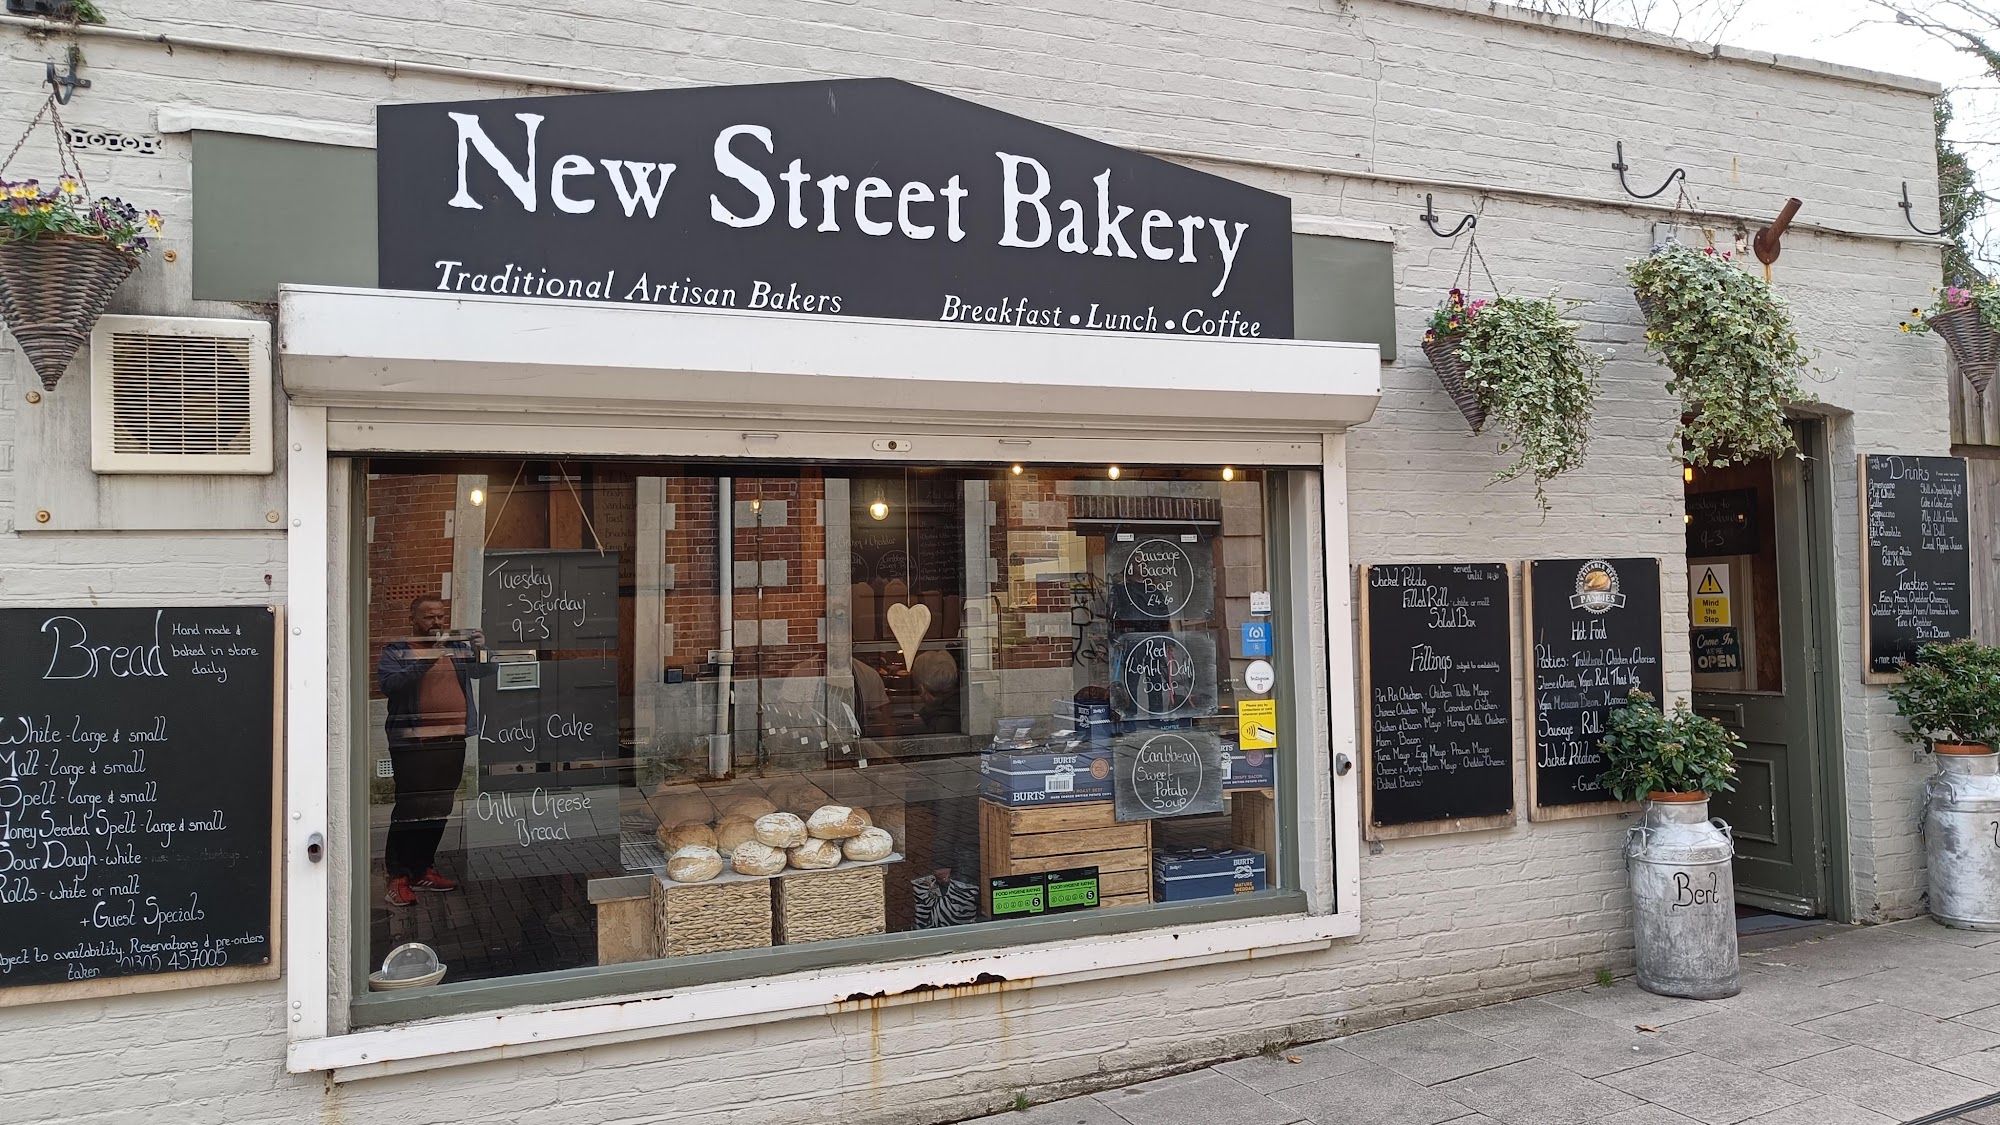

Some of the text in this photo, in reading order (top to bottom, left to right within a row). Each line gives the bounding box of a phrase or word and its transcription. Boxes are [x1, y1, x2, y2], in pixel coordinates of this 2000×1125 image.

[448, 111, 1250, 298] New Street Bakery
[435, 260, 842, 313] Traditional Artisan Bakers
[940, 294, 1261, 338] Breakfast Lunch Coffee
[1886, 456, 1930, 481] Drinks
[1135, 548, 1180, 567] Sausage
[489, 560, 553, 597] Tuesday
[1138, 562, 1177, 577] Bacon
[1372, 564, 1472, 587] Jacket Potato served
[1896, 568, 1928, 591] Toasties
[1143, 578, 1173, 593] Bap
[1403, 588, 1427, 608] Filled
[1427, 586, 1449, 607] Roll
[1580, 594, 1615, 604] PASTIES
[519, 590, 586, 627] Saturday
[1428, 607, 1476, 628] Salad Box
[1571, 618, 1607, 640] Hot Food
[1704, 616, 1719, 624] Step
[1697, 633, 1734, 649] Come In
[1932, 626, 1950, 638] Bacon
[40, 610, 232, 679] Bread Hand made
[171, 643, 259, 657] baked in store
[1146, 640, 1167, 660] Red
[192, 661, 227, 683] daily
[1128, 657, 1161, 676] Lentil
[1410, 643, 1452, 684] Fillings
[1697, 654, 1736, 669] OPEN
[1143, 677, 1178, 694] Soup
[1595, 667, 1609, 686] Red
[1610, 666, 1627, 685] Thai
[0, 714, 62, 745] White
[128, 716, 168, 742] small
[479, 713, 594, 752] Lardy Cake
[1539, 711, 1604, 741] Sausage Rolls
[1375, 731, 1421, 746] Ham Bacon
[0, 749, 39, 777] Malt
[103, 749, 146, 774] small
[1053, 756, 1077, 764] BURTS
[1142, 745, 1197, 766] Caribbean
[1415, 745, 1428, 763] Egg
[1538, 741, 1600, 767] Jacket Potatoes
[1137, 764, 1173, 782] Sweet
[1013, 791, 1045, 801] BURTS
[1156, 777, 1188, 796] Potato
[0, 777, 56, 821] Spelt
[119, 781, 157, 802] small
[476, 786, 592, 824] Chilli Cheese
[1153, 797, 1186, 808] Soup
[39, 810, 90, 838] Seeded
[96, 809, 137, 850] Spelt
[188, 810, 227, 831] small
[514, 818, 570, 847] Bread
[1233, 857, 1255, 866] BURTS
[50, 878, 87, 900] white
[92, 885, 104, 897] or
[110, 874, 140, 896] malt
[1672, 871, 1719, 911] Bert
[93, 899, 136, 928] Guest
[143, 891, 205, 935] Specials
[34, 947, 48, 963] to
[130, 935, 198, 954] Reservations
[216, 932, 265, 951] pre-orders
[68, 964, 100, 980] taken
[168, 947, 228, 970] 457005
